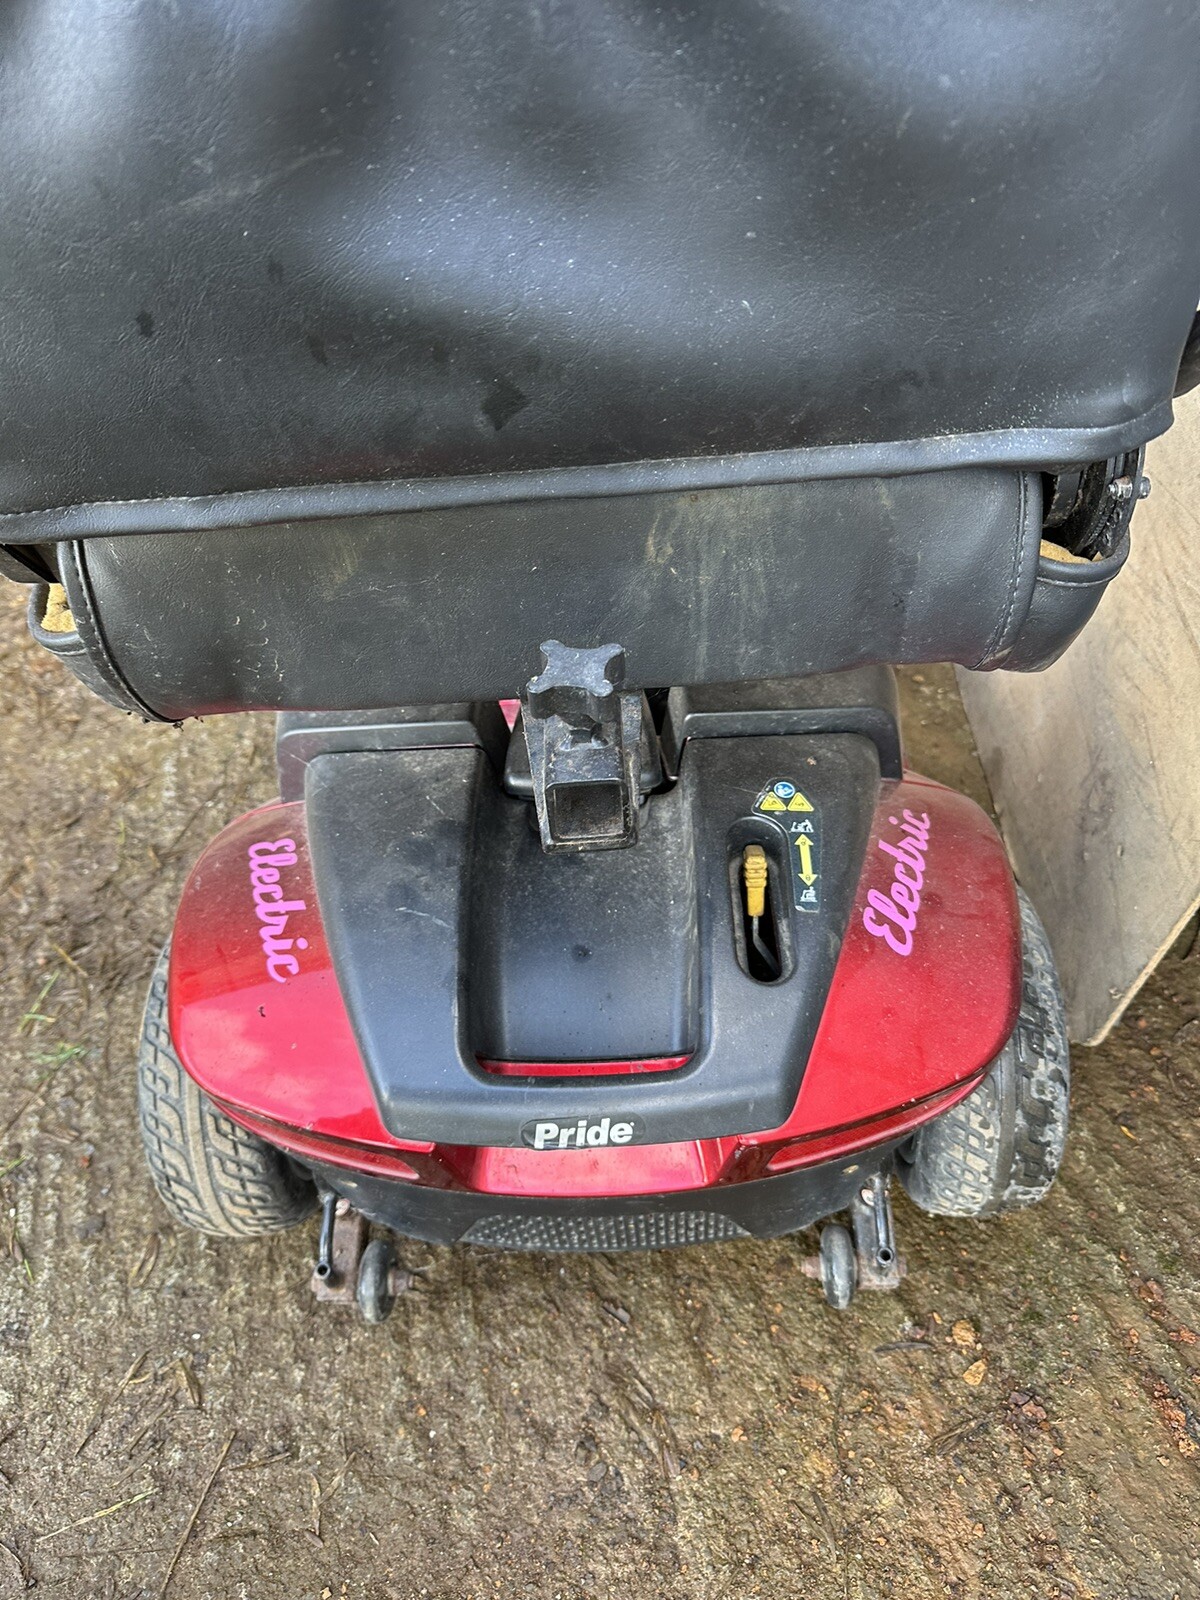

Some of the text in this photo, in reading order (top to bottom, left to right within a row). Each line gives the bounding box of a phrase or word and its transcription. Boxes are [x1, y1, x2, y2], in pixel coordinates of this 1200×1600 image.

[248, 838, 308, 983] Electric
[863, 809, 931, 956] Electric
[534, 1118, 634, 1149] Pride
